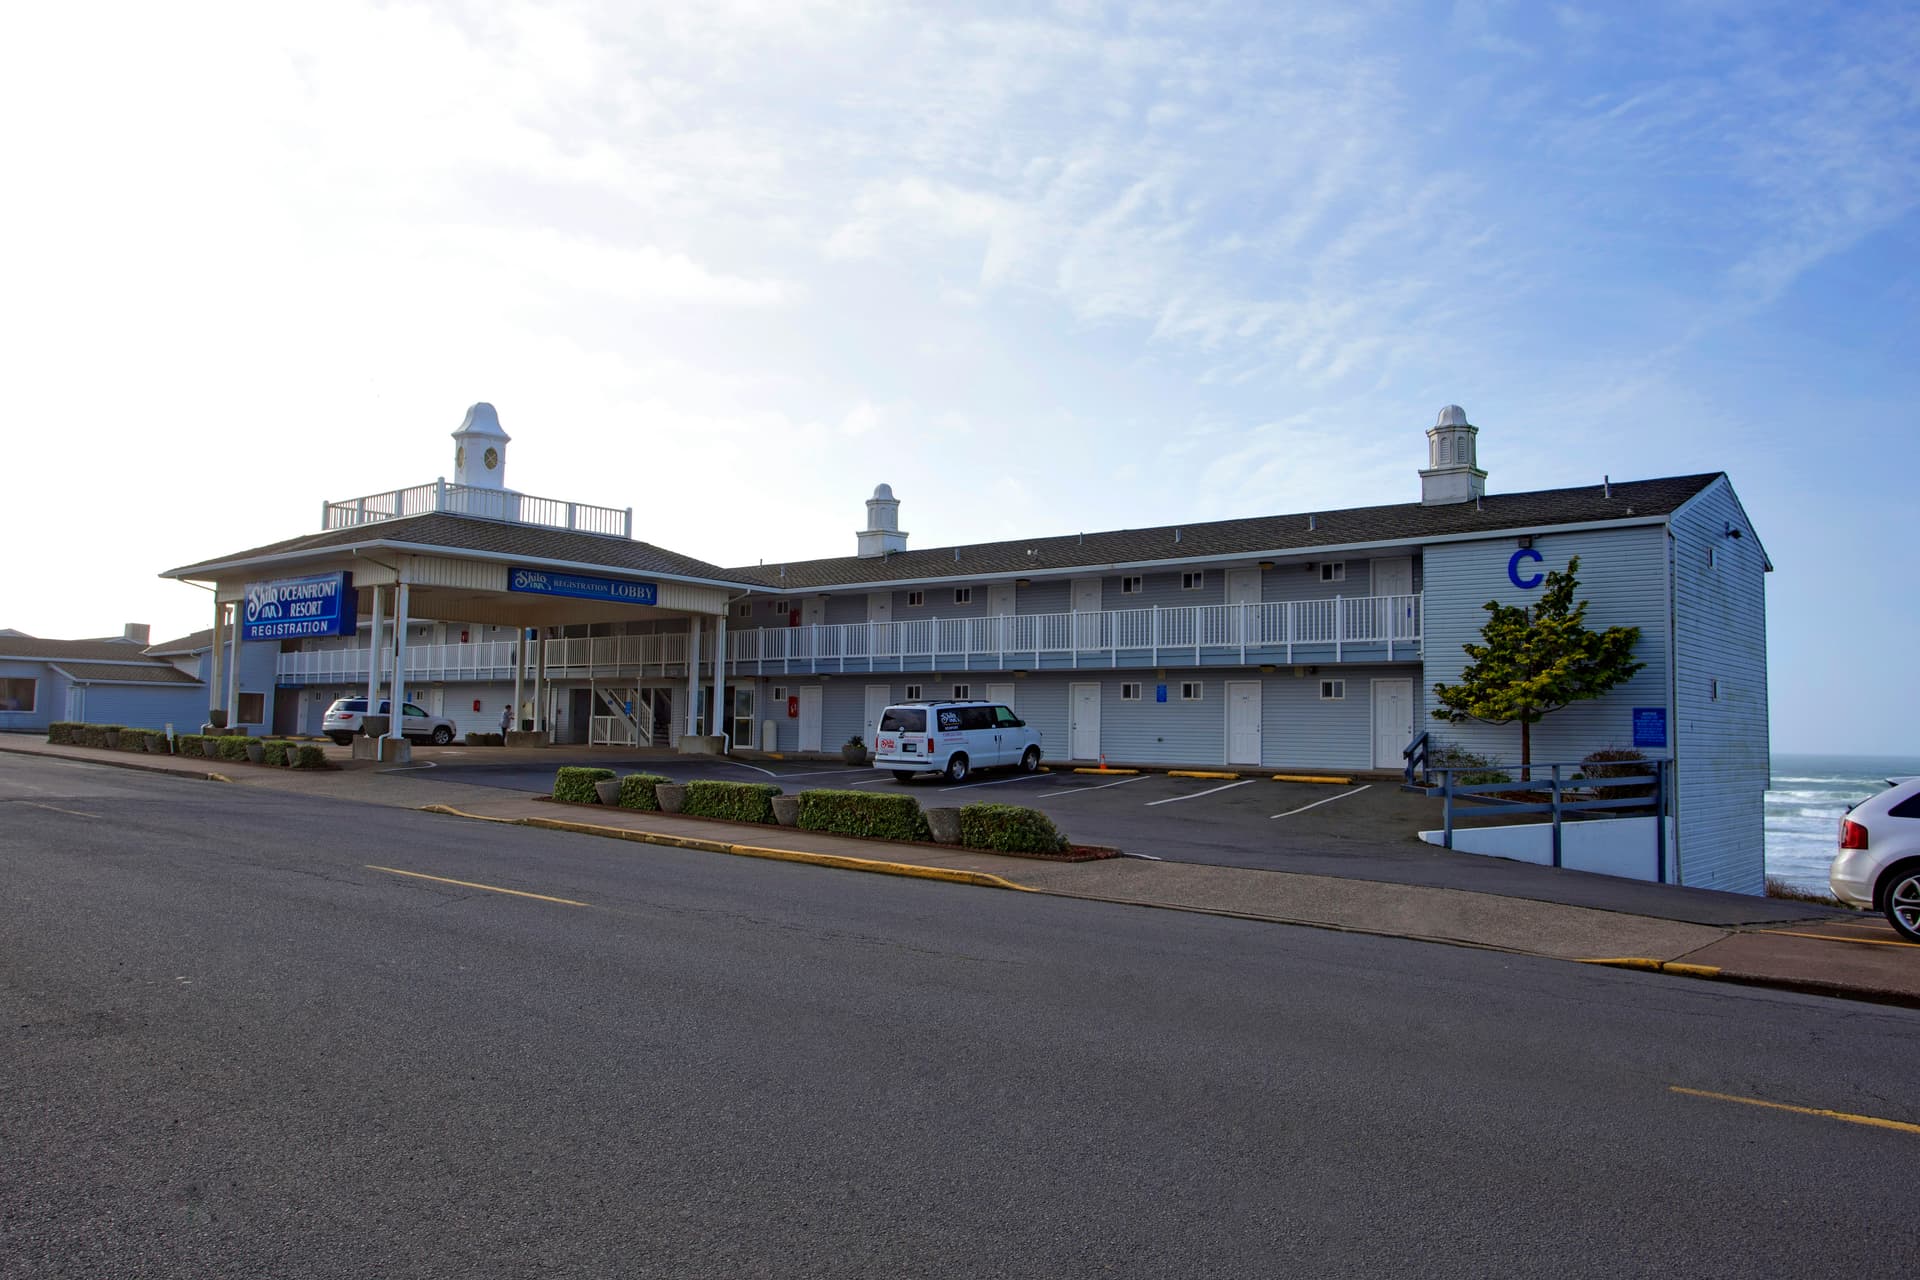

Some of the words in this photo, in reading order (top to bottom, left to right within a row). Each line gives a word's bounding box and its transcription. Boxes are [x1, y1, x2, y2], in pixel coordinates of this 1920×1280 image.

[1508, 548, 1544, 589] C
[515, 570, 547, 588] Shilo
[553, 579, 608, 592] REGISTRATION
[610, 583, 654, 599] LOBBY
[280, 581, 337, 602] OCEANFRONT
[247, 585, 279, 621] Shilo
[290, 600, 323, 617] RESORT
[251, 621, 328, 637] REGISTRATION
